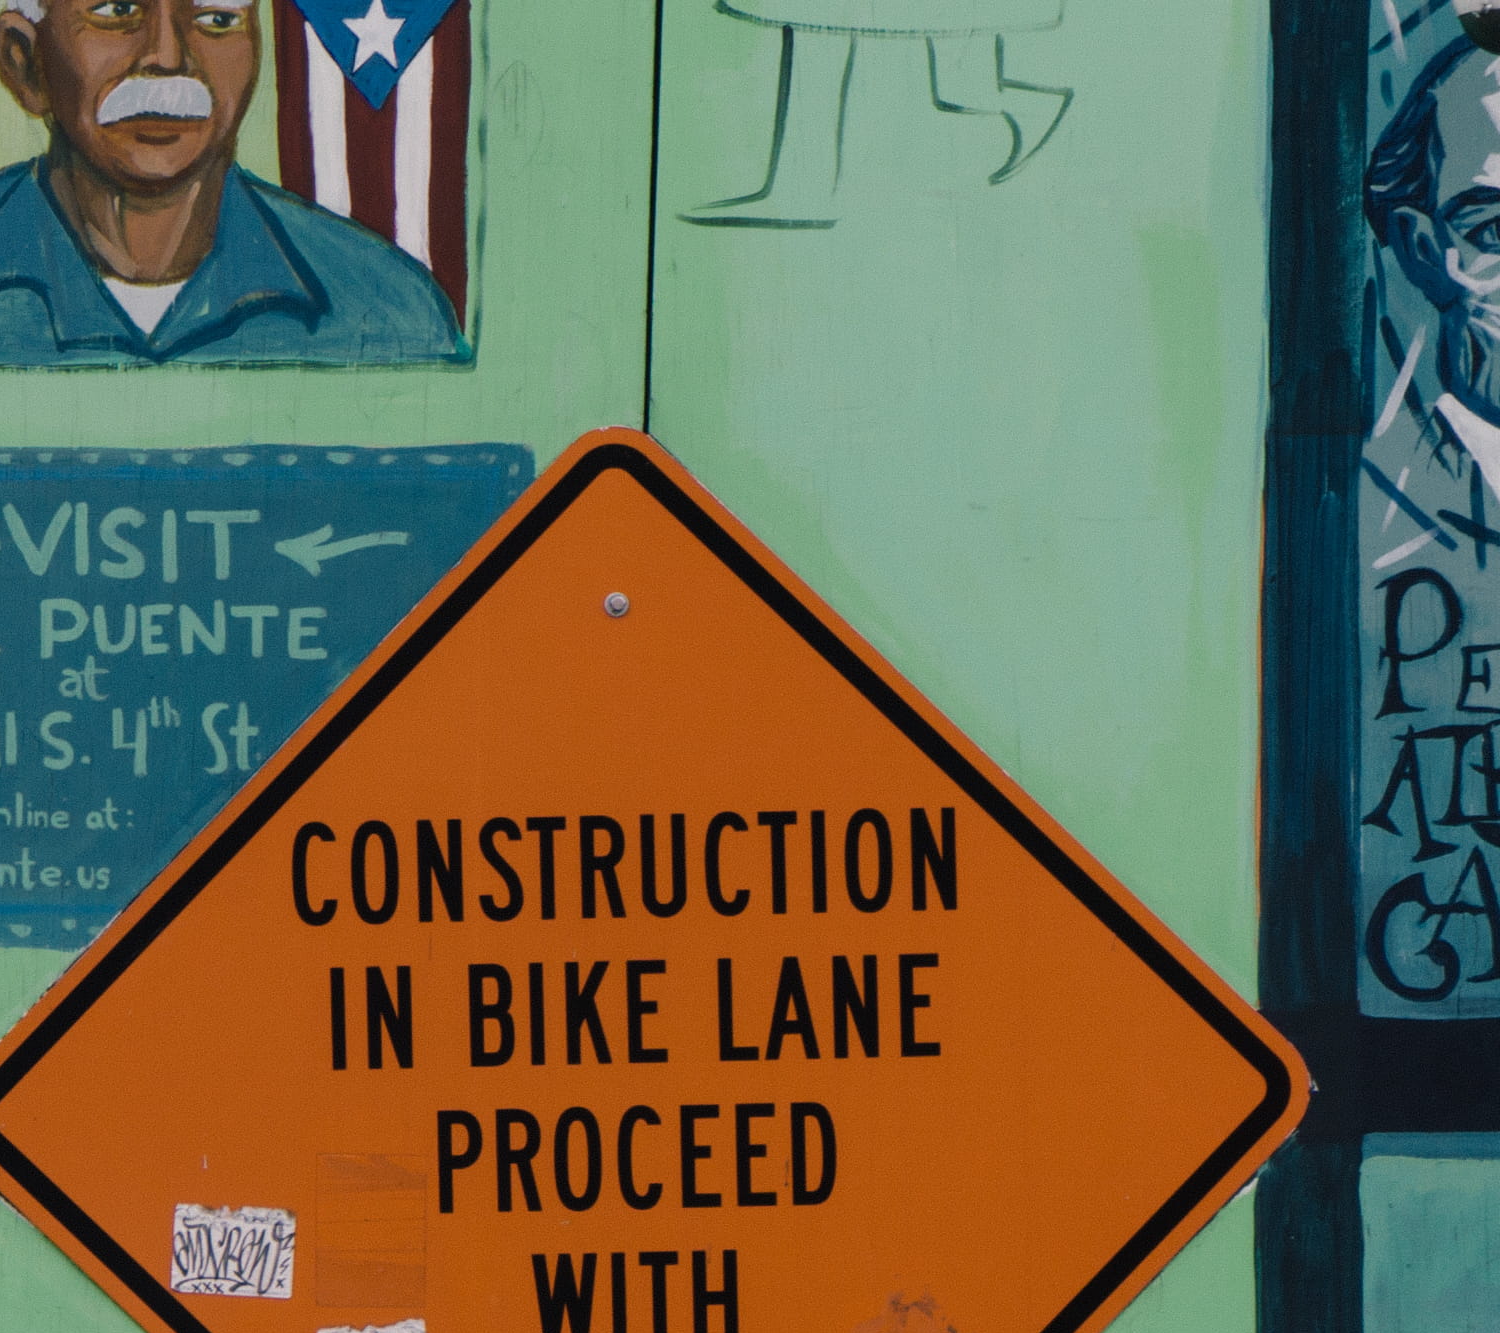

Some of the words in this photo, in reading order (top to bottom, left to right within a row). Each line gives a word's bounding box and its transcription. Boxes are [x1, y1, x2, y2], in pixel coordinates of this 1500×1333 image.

[3, 502, 260, 584] VISIT
[41, 599, 329, 659] PUENTE
[58, 656, 110, 702] at
[111, 696, 181, 777] 4th
[290, 806, 960, 928] CONSTRUCTION
[328, 965, 416, 1071] IN
[467, 957, 670, 1068] BIKE
[715, 952, 943, 1063] LANE
[435, 1101, 839, 1215] PROCEED
